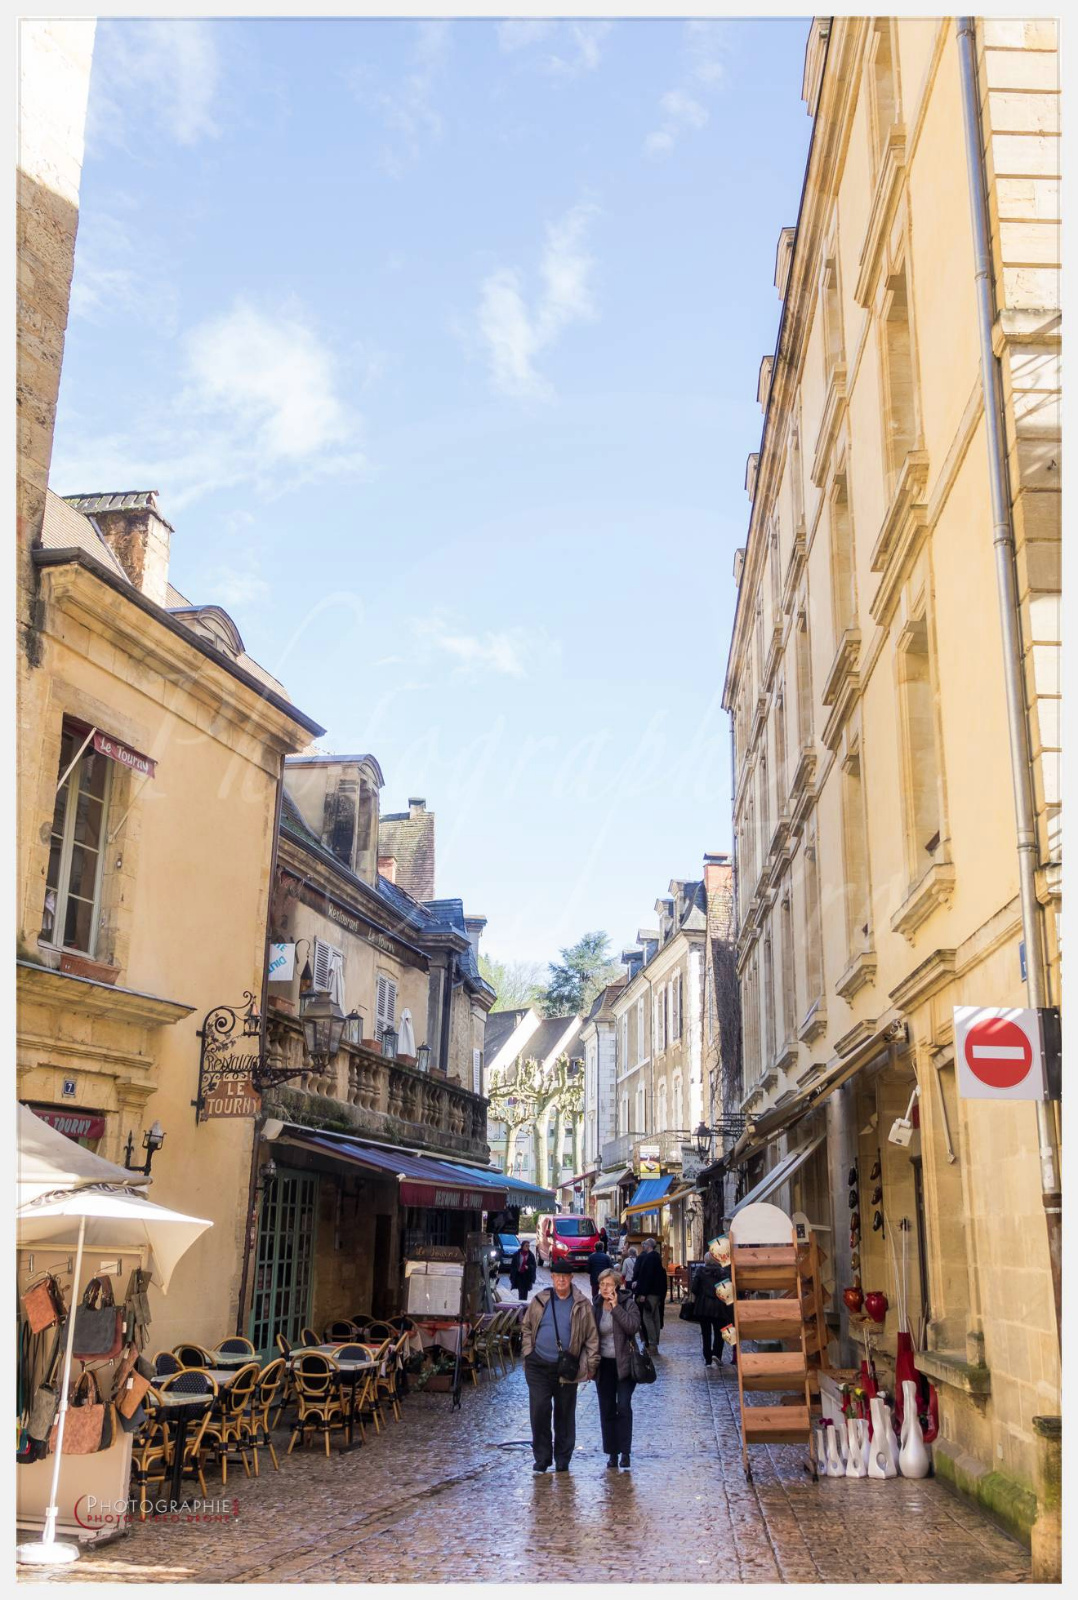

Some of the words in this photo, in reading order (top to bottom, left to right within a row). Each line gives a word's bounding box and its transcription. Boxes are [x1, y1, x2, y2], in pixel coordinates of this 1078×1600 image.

[100, 736, 112, 753] Le
[117, 746, 149, 773] Tourny
[67, 1083, 73, 1092] 7
[227, 1082, 246, 1096] LE
[207, 1097, 260, 1115] TOURNY
[54, 1117, 92, 1135] TOURNY
